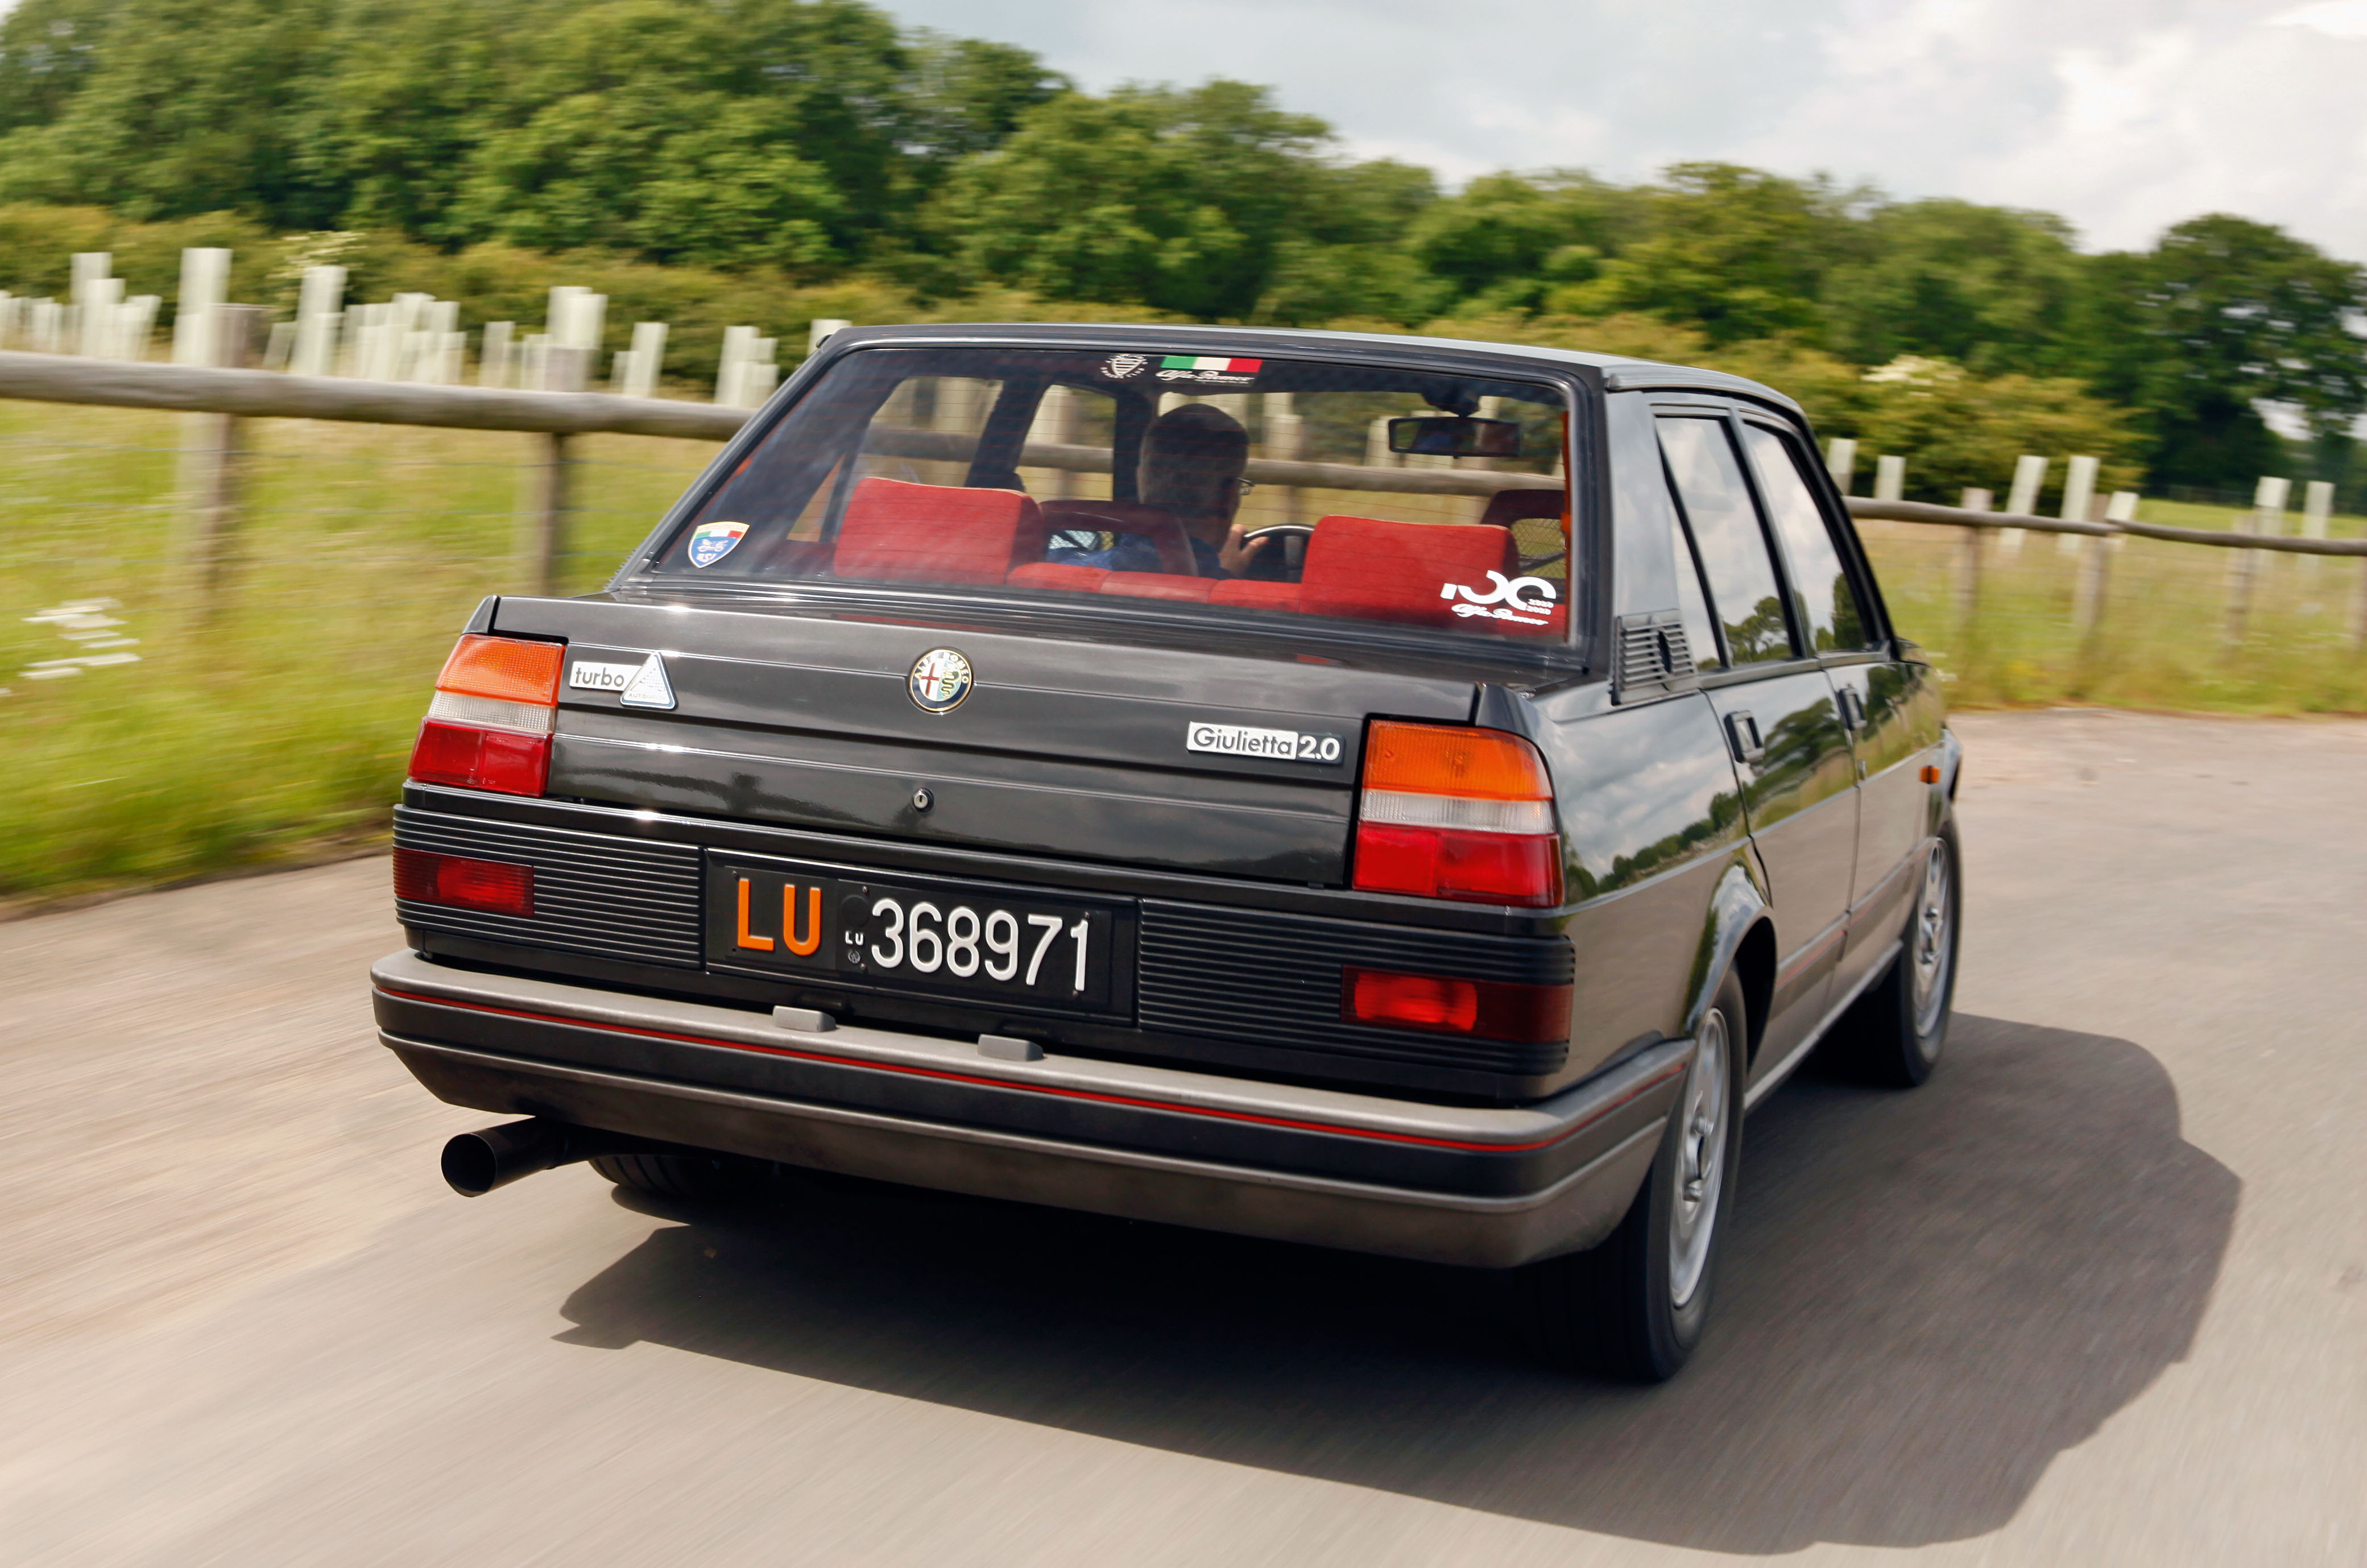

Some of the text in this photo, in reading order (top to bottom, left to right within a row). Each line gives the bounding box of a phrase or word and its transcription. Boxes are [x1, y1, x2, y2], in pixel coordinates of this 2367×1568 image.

[576, 667, 624, 687] turbo
[943, 652, 969, 684] ROMEO
[1194, 727, 1340, 761] Giulietta 2.0
[737, 879, 1089, 992] LU 368971
[845, 930, 864, 946] LU
